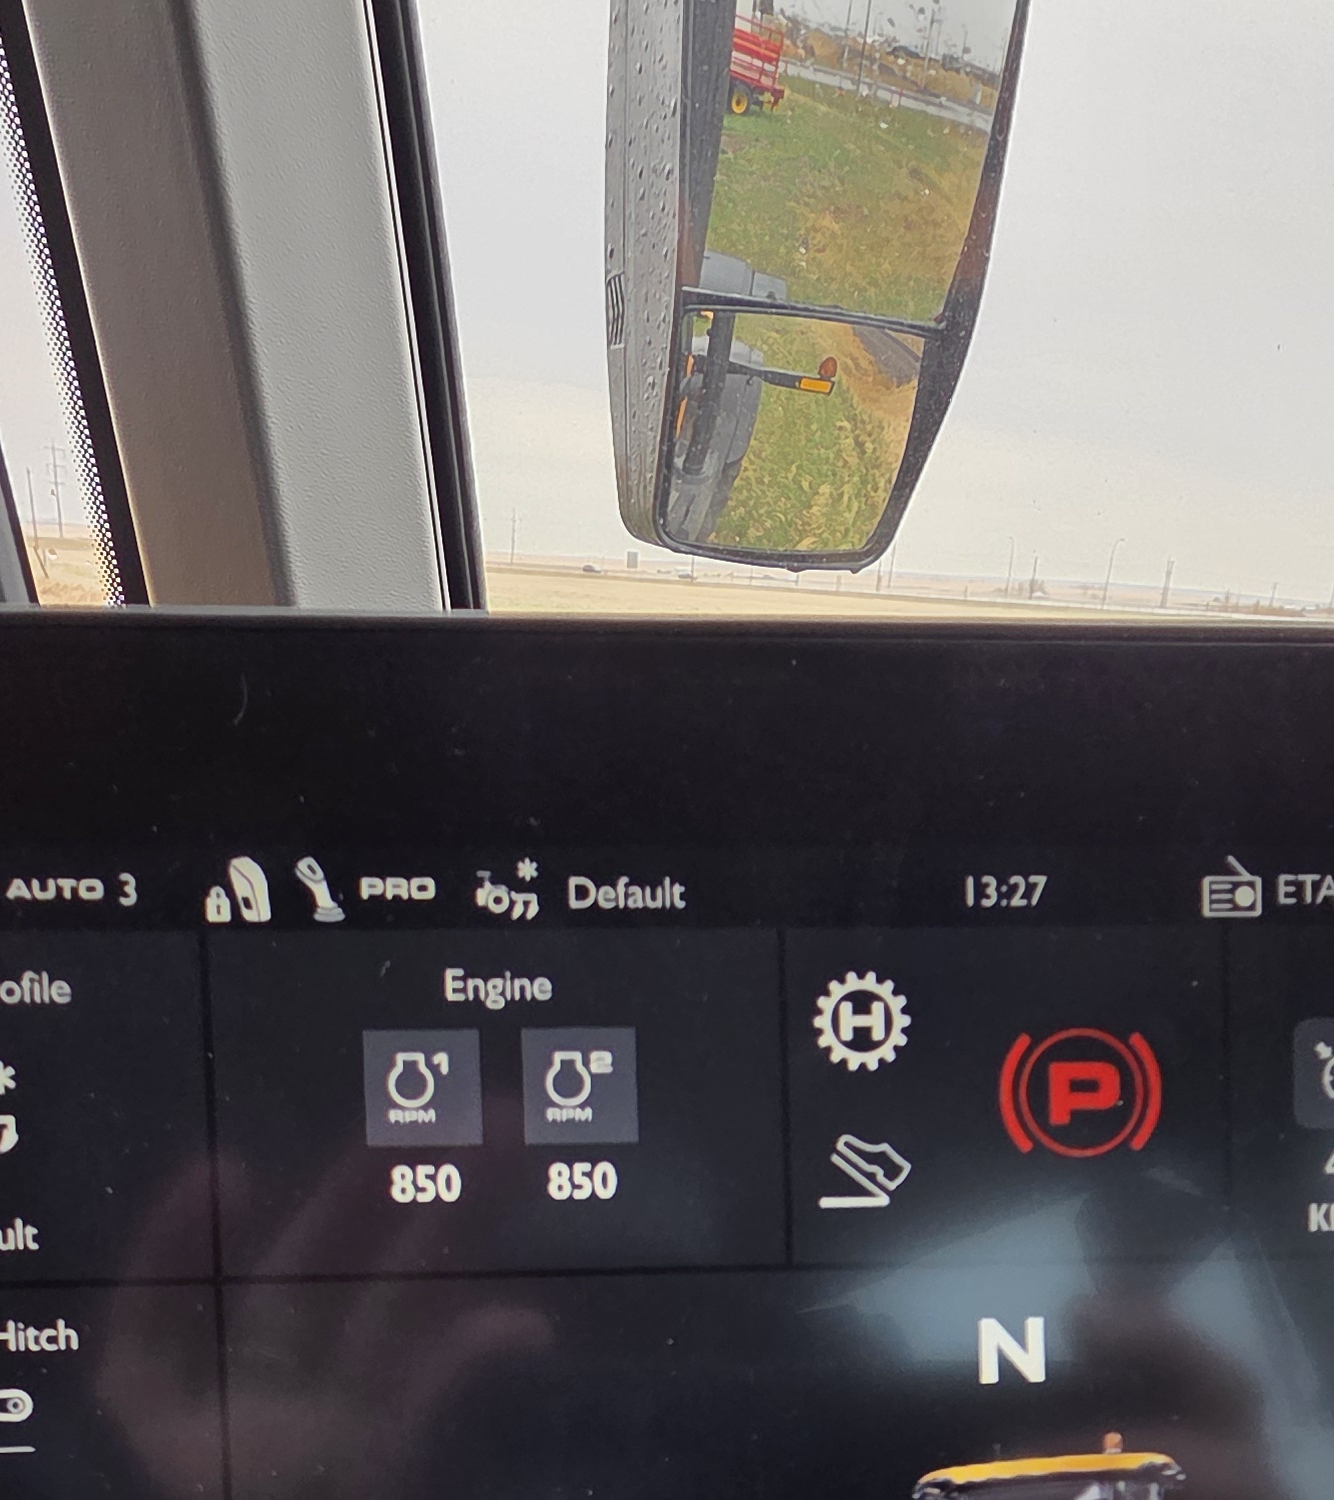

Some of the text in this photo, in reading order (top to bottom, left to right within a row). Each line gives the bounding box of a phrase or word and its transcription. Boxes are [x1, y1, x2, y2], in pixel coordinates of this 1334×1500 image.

[6, 873, 137, 906] AUTO 3
[360, 877, 436, 900] PRO
[568, 876, 686, 910] Default
[964, 875, 1048, 908] 13:27
[444, 967, 552, 1010] Engine
[432, 1052, 449, 1075] 1
[1047, 1061, 1121, 1125] P
[388, 1108, 436, 1124] RPM
[546, 1107, 593, 1123] RPM
[390, 1164, 462, 1203] 850
[547, 1161, 618, 1200] 850
[978, 1316, 1046, 1384] N
